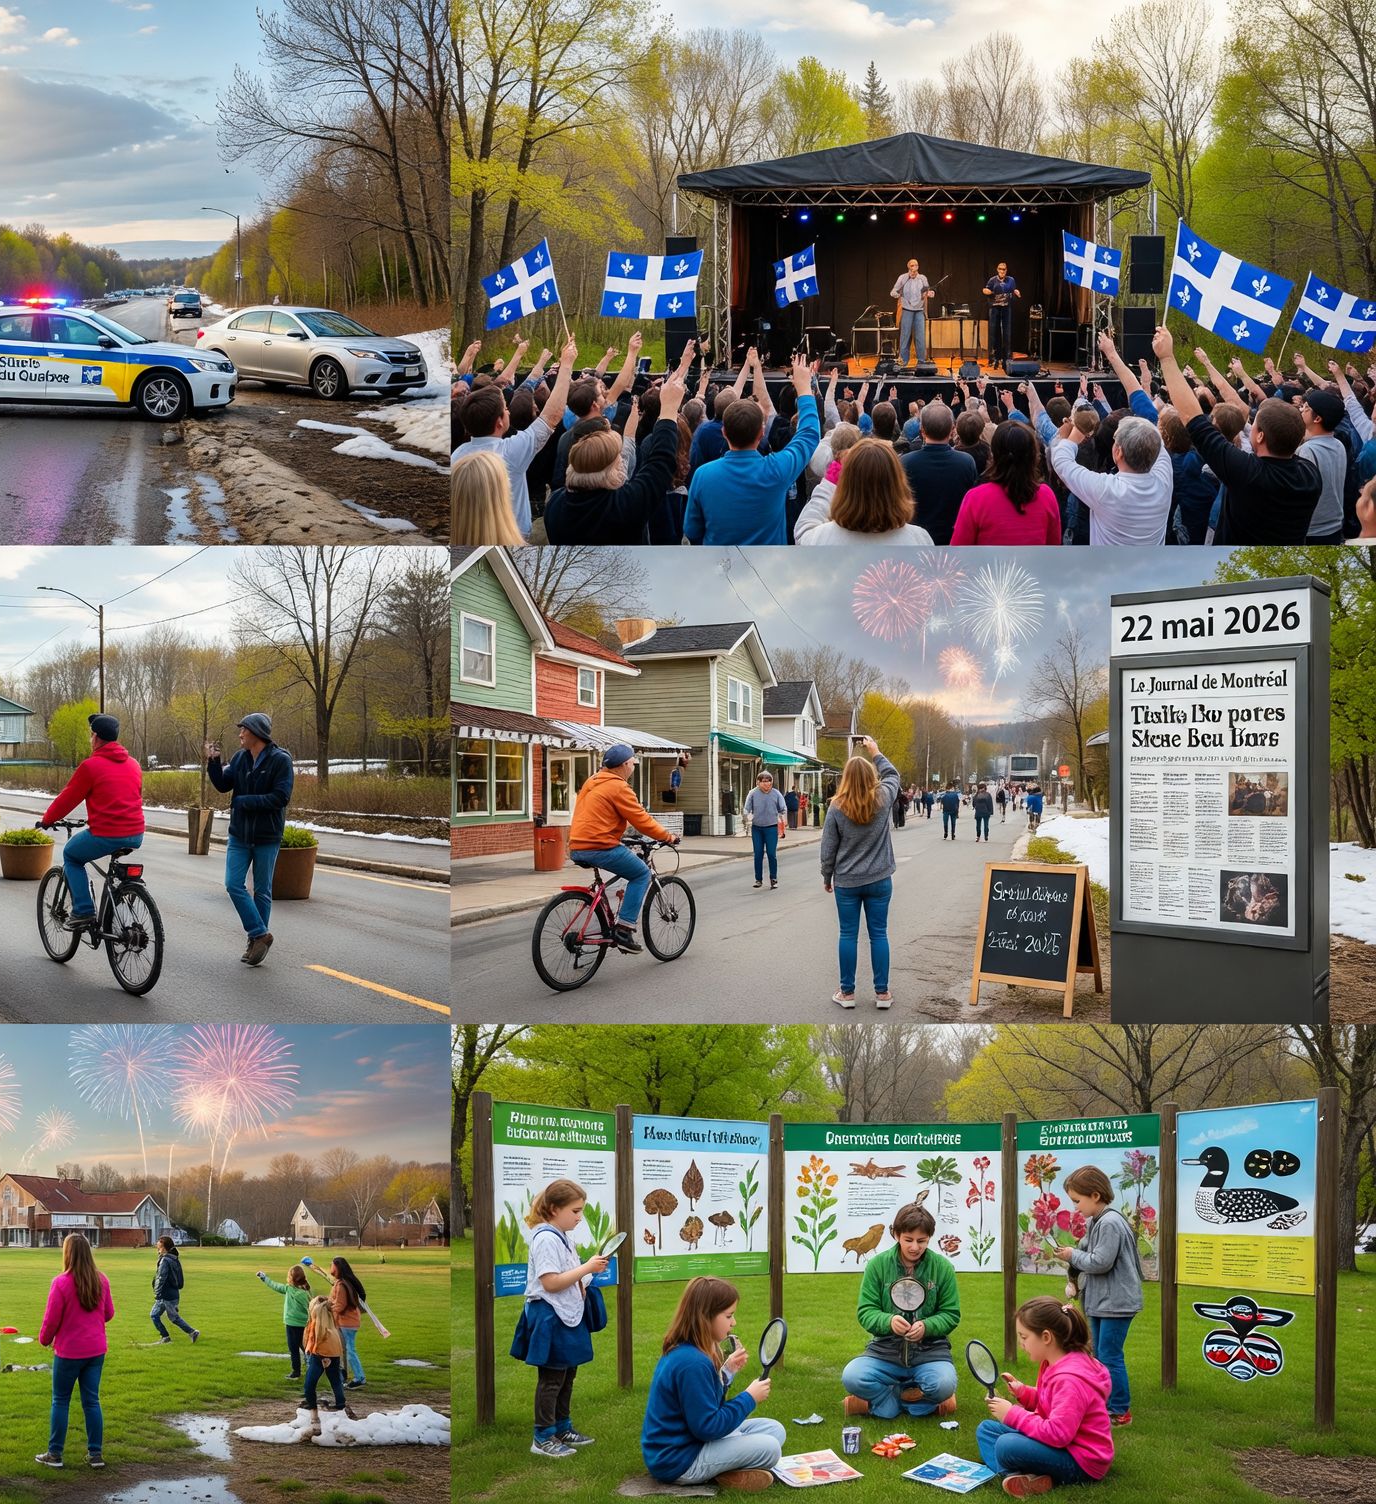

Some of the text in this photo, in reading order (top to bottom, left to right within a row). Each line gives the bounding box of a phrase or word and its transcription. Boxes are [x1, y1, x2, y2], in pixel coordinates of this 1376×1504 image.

[1121, 601, 1301, 642] 22 mai 2026
[1148, 674, 1198, 695] Journal
[1201, 674, 1218, 690] de
